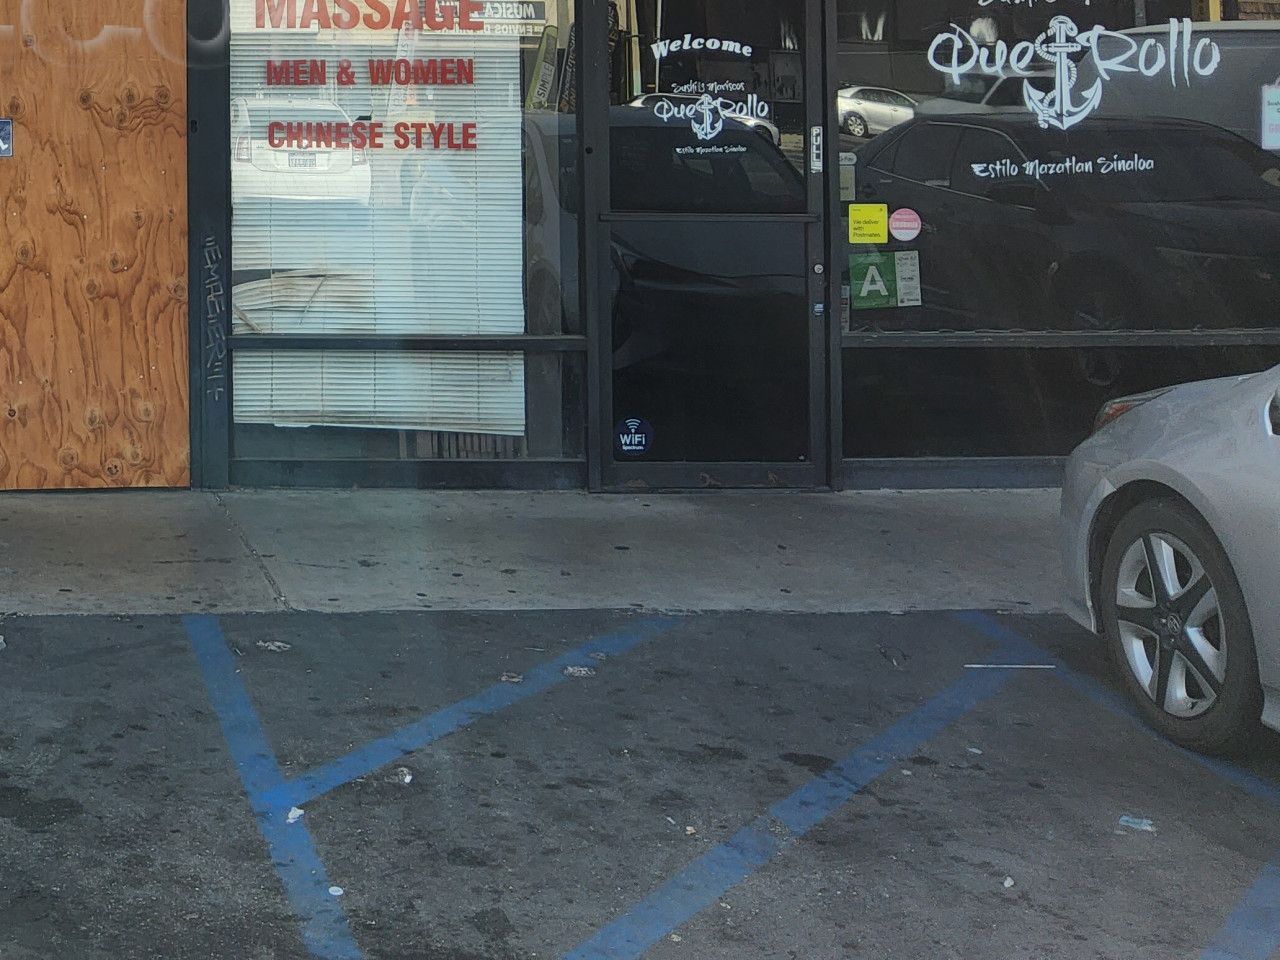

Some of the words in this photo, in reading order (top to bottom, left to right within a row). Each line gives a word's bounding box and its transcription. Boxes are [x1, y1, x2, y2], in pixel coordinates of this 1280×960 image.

[650, 34, 752, 60] Welcome
[927, 23, 1035, 84] Que
[1077, 18, 1220, 87] Rollo
[266, 60, 326, 85] MEN
[337, 60, 356, 85] &
[370, 59, 474, 85] WOMEN
[654, 98, 696, 122] Que
[713, 94, 768, 119] Rollo
[268, 122, 383, 149] CHINESE
[394, 122, 477, 150] STYLE
[813, 128, 821, 162] PULL
[971, 159, 1018, 178] Estilo
[1022, 156, 1092, 179] Mazatlan
[1097, 154, 1154, 174] Sinaloa
[860, 266, 888, 296] A
[620, 434, 645, 445] WiFi
